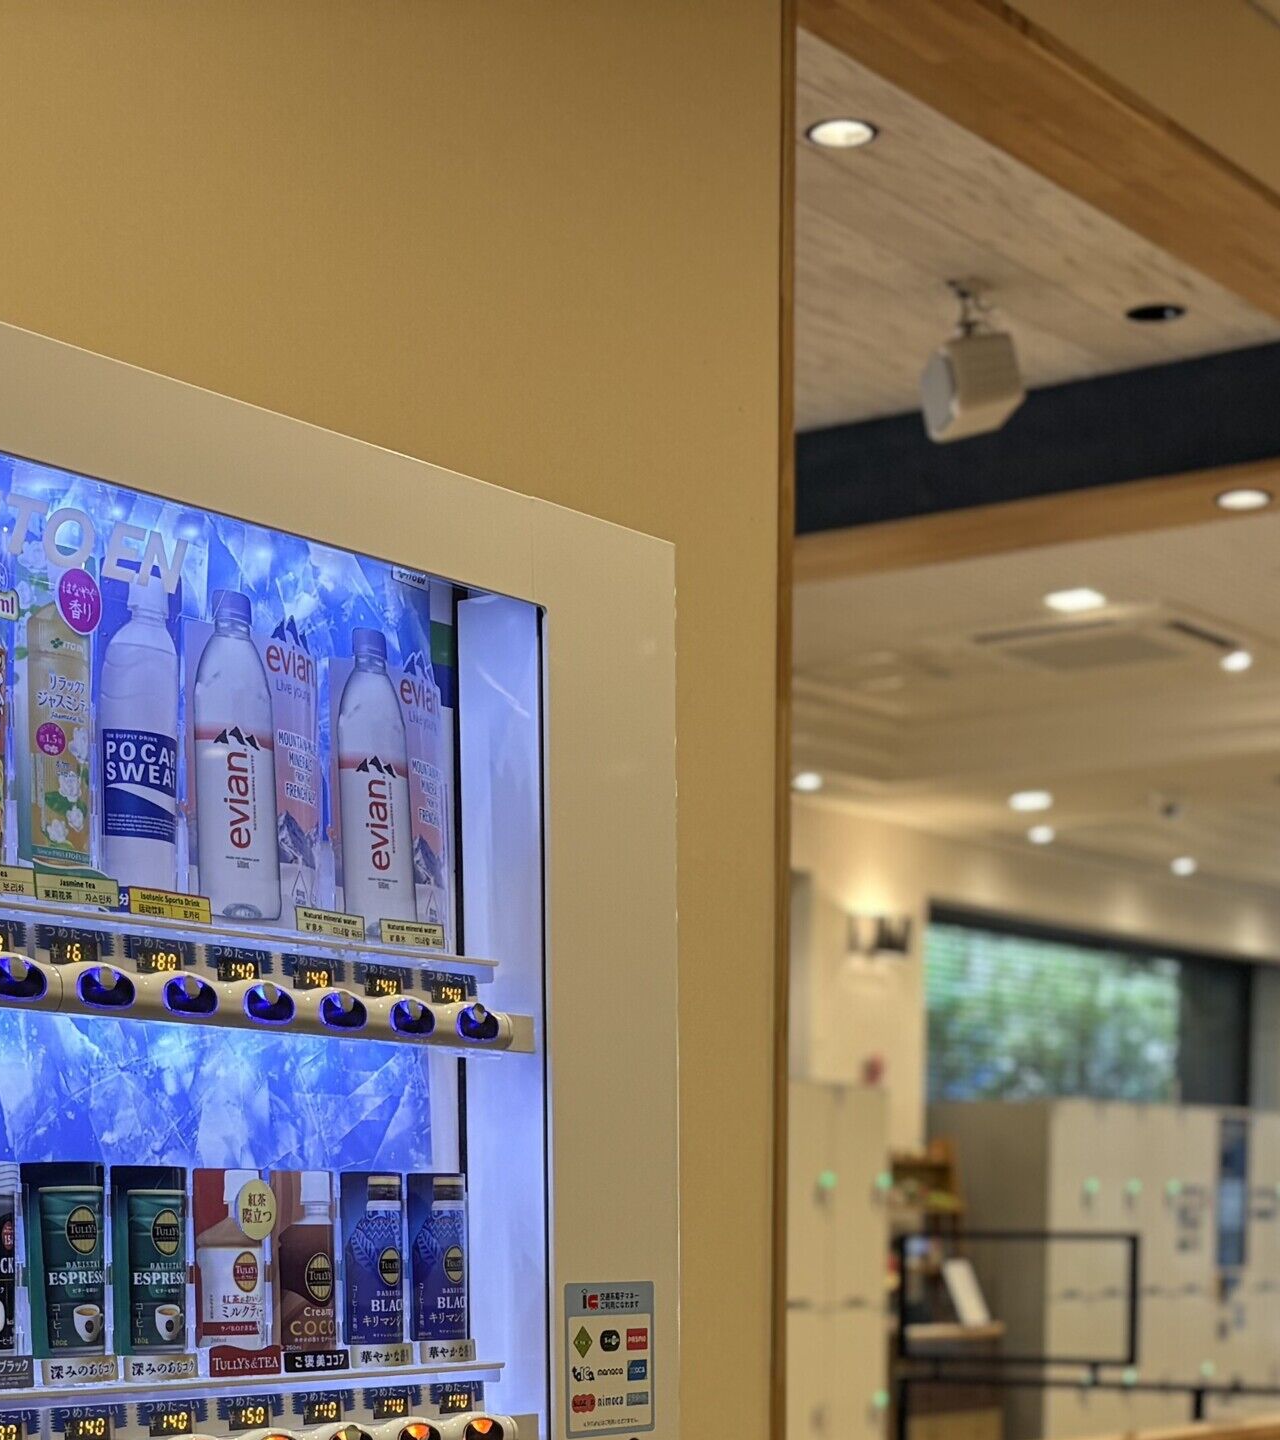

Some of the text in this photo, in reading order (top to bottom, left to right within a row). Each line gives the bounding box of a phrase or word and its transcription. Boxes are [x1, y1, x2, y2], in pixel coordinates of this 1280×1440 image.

[101, 521, 189, 594] EN
[69, 600, 93, 622] 香り
[266, 644, 315, 687] evian
[230, 750, 251, 849] evian
[368, 777, 391, 871] evian
[60, 879, 96, 889] Jasmine Tea
[248, 1193, 267, 1207] 紅茶
[133, 1272, 185, 1285] ESPRESS
[294, 1354, 344, 1368] ご褒美ココア
